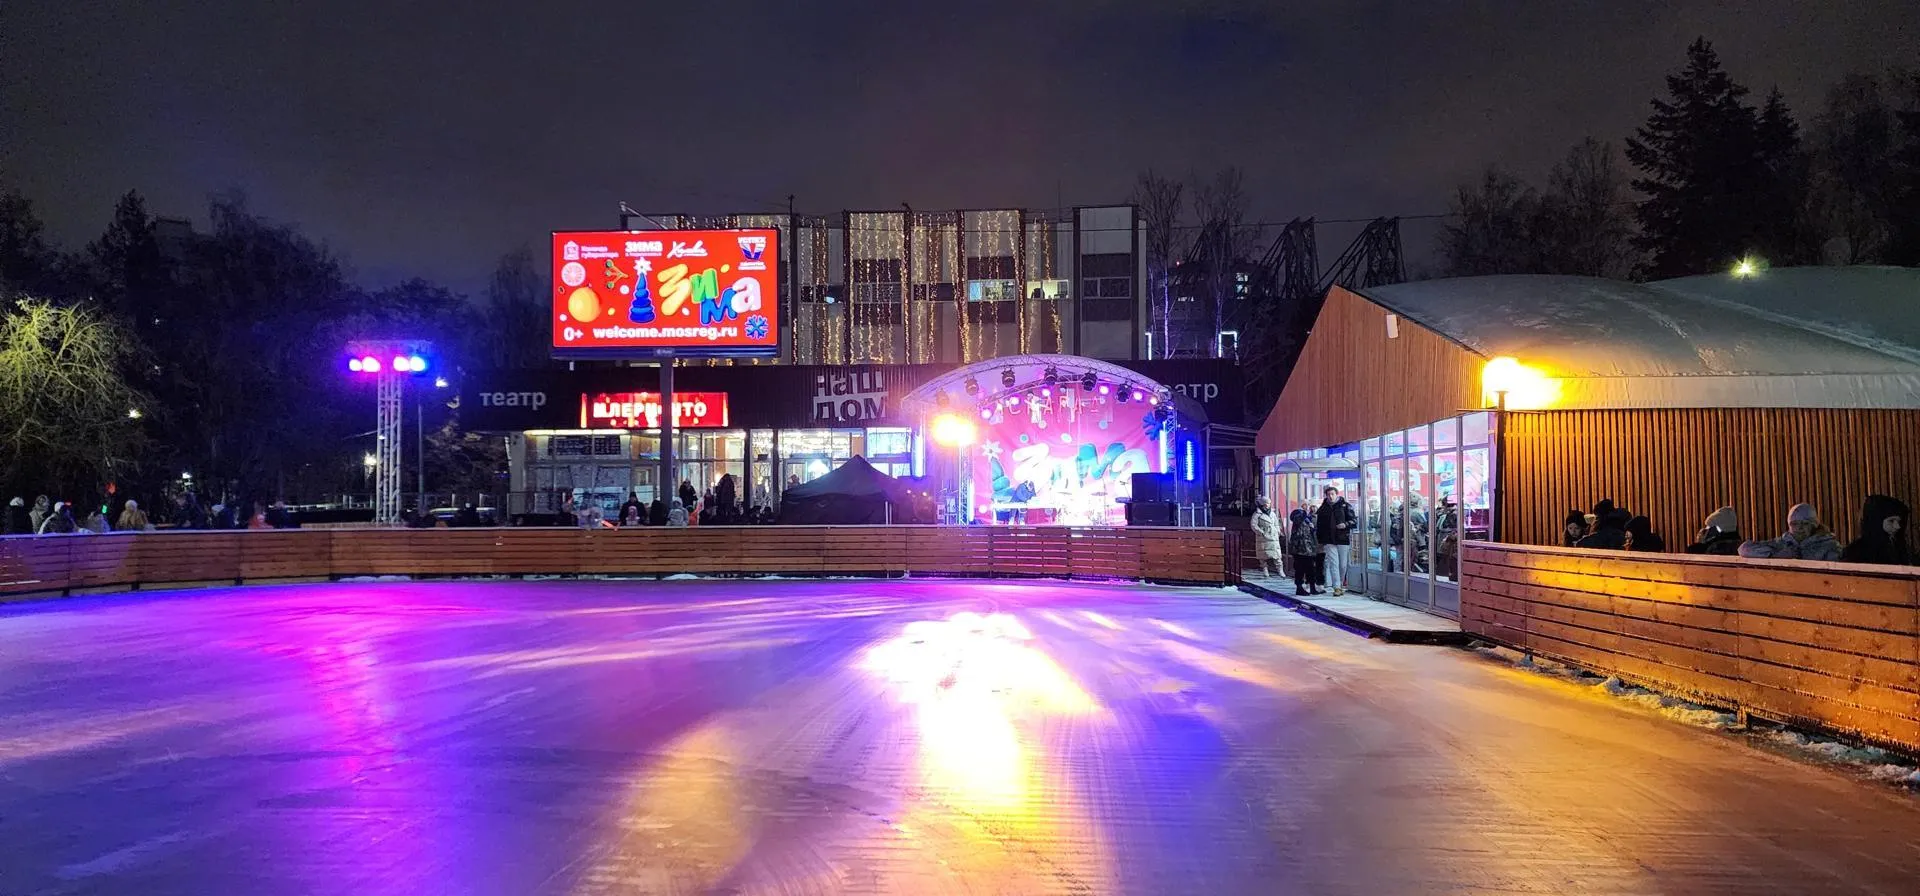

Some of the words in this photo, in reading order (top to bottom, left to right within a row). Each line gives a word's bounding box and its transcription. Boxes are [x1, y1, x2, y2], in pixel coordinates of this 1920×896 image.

[563, 327, 584, 342] 0+
[592, 326, 738, 341] welcome.mosreg.ru
[479, 391, 547, 411] театр
